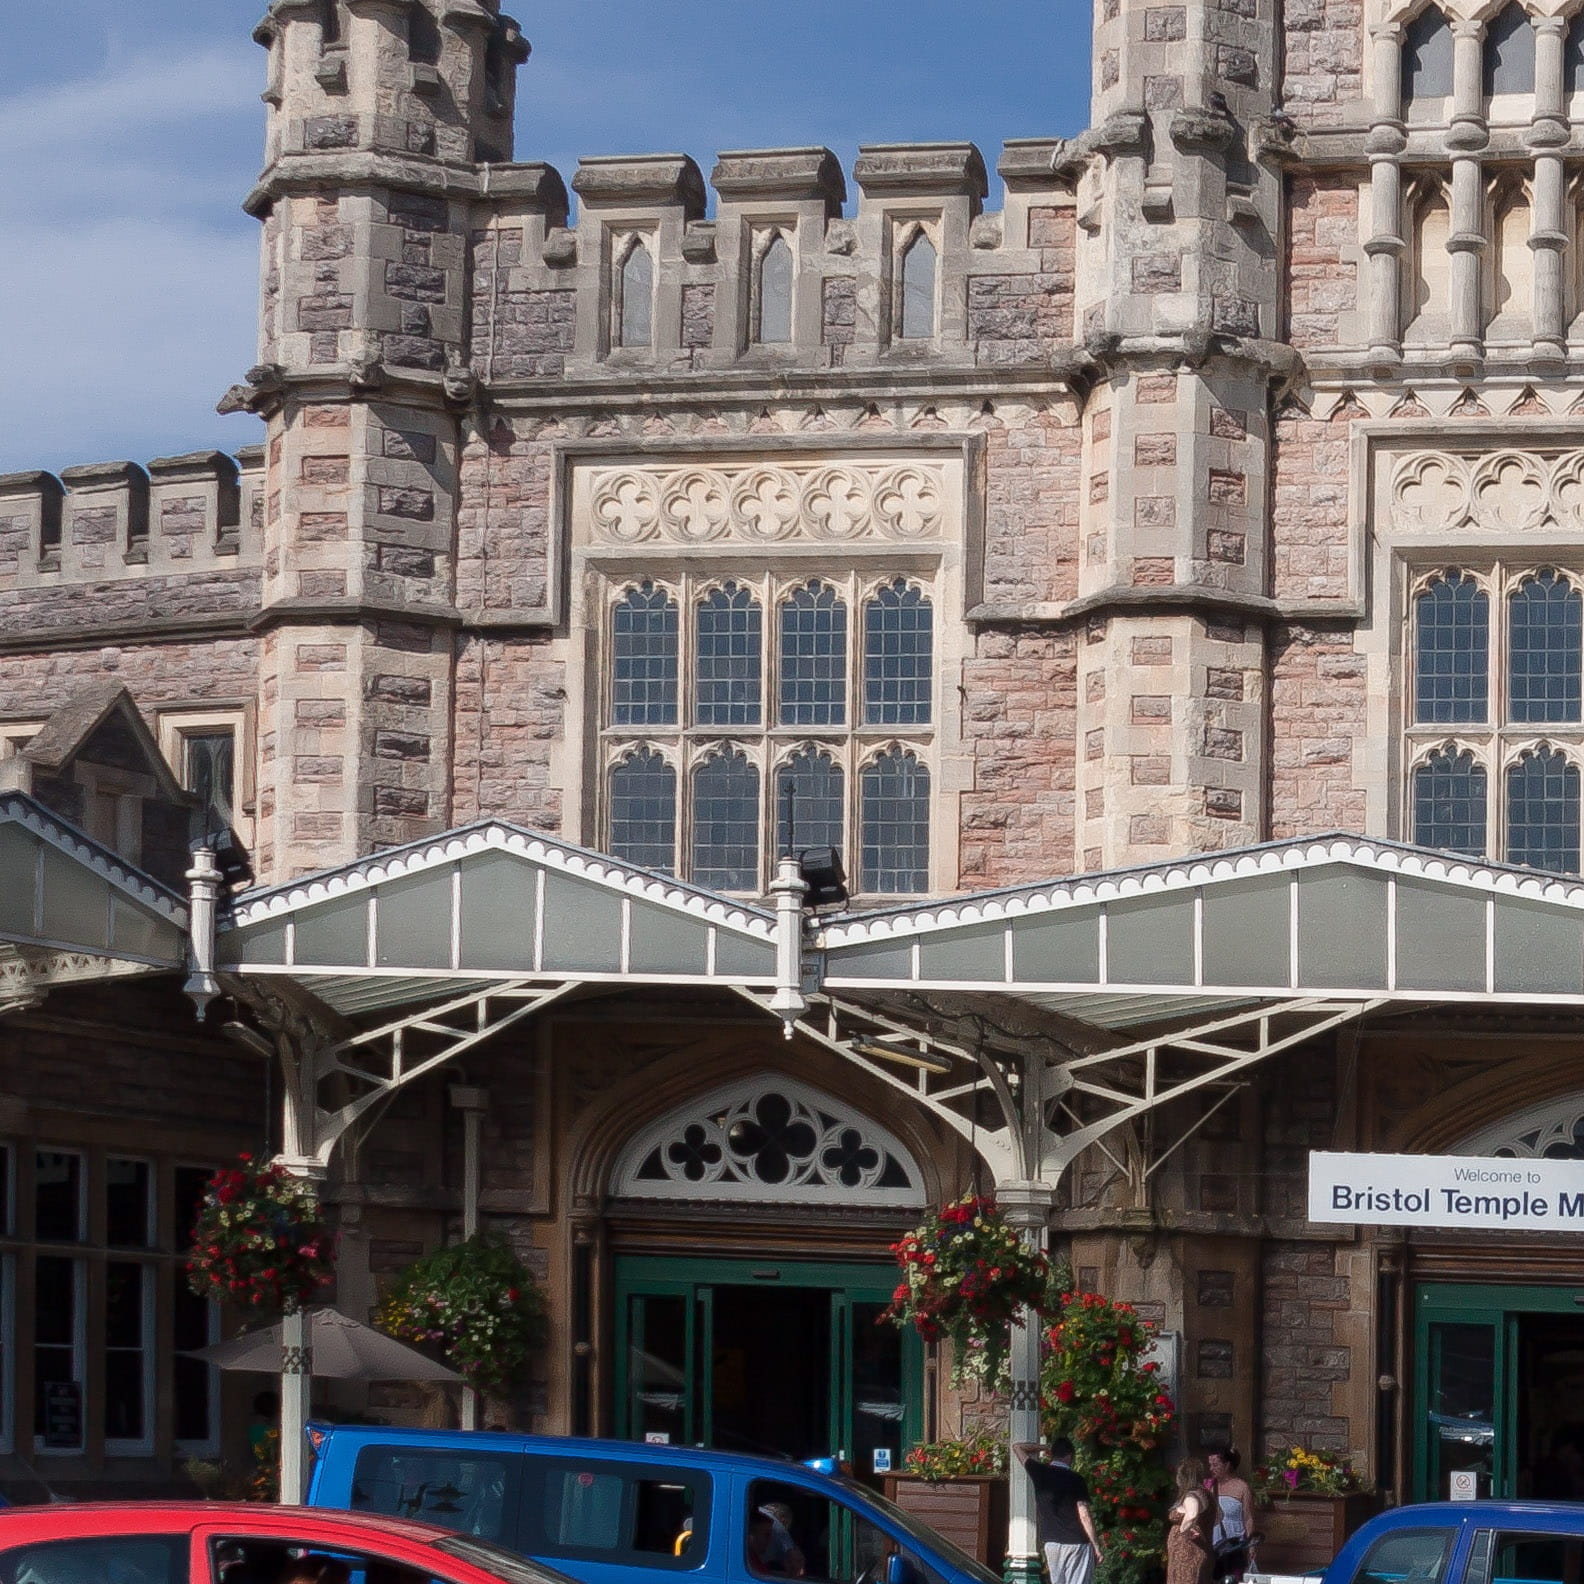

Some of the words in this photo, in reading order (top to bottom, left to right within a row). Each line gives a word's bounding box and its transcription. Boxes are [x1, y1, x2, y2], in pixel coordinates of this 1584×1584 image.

[1454, 1167, 1522, 1183] Welcome
[1527, 1171, 1541, 1184] to
[1332, 1185, 1430, 1213] Bristol
[1440, 1188, 1548, 1220] Temple
